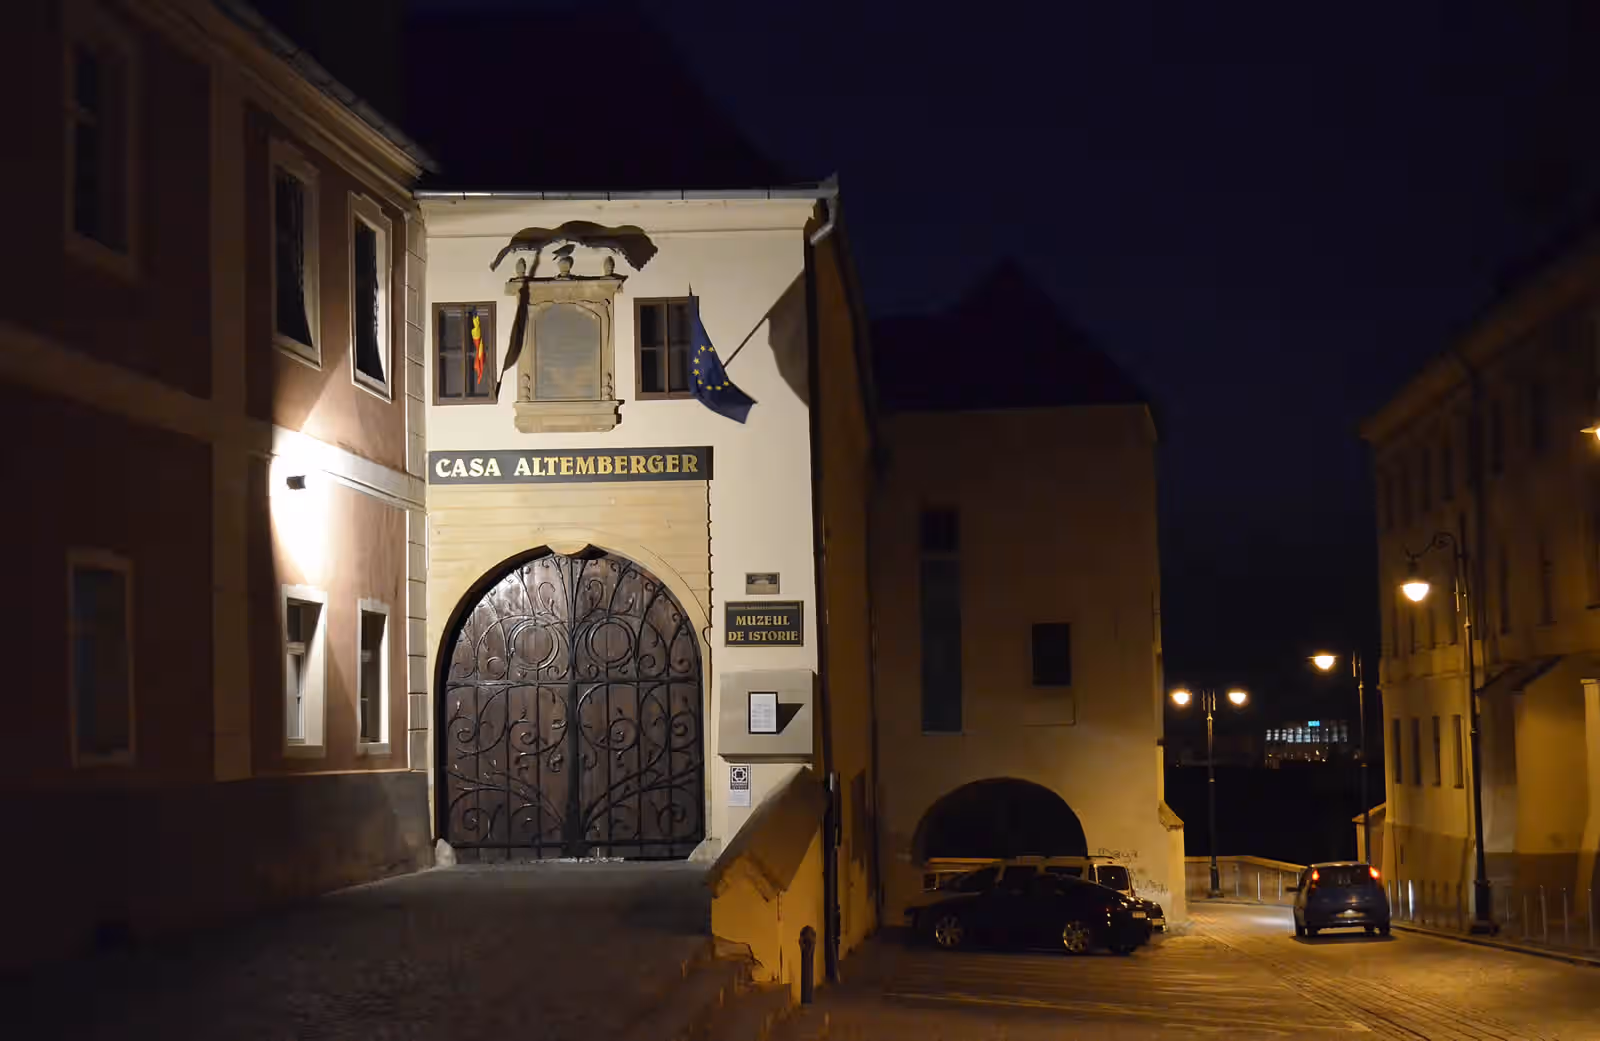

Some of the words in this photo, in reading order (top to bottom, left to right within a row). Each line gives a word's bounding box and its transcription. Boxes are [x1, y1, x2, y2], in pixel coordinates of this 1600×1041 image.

[435, 458, 501, 477] CASA
[513, 454, 698, 476] ALTEMBERGER
[735, 615, 790, 626] MUZEUL
[728, 631, 744, 641] DE
[749, 631, 798, 641] ISTORIE
